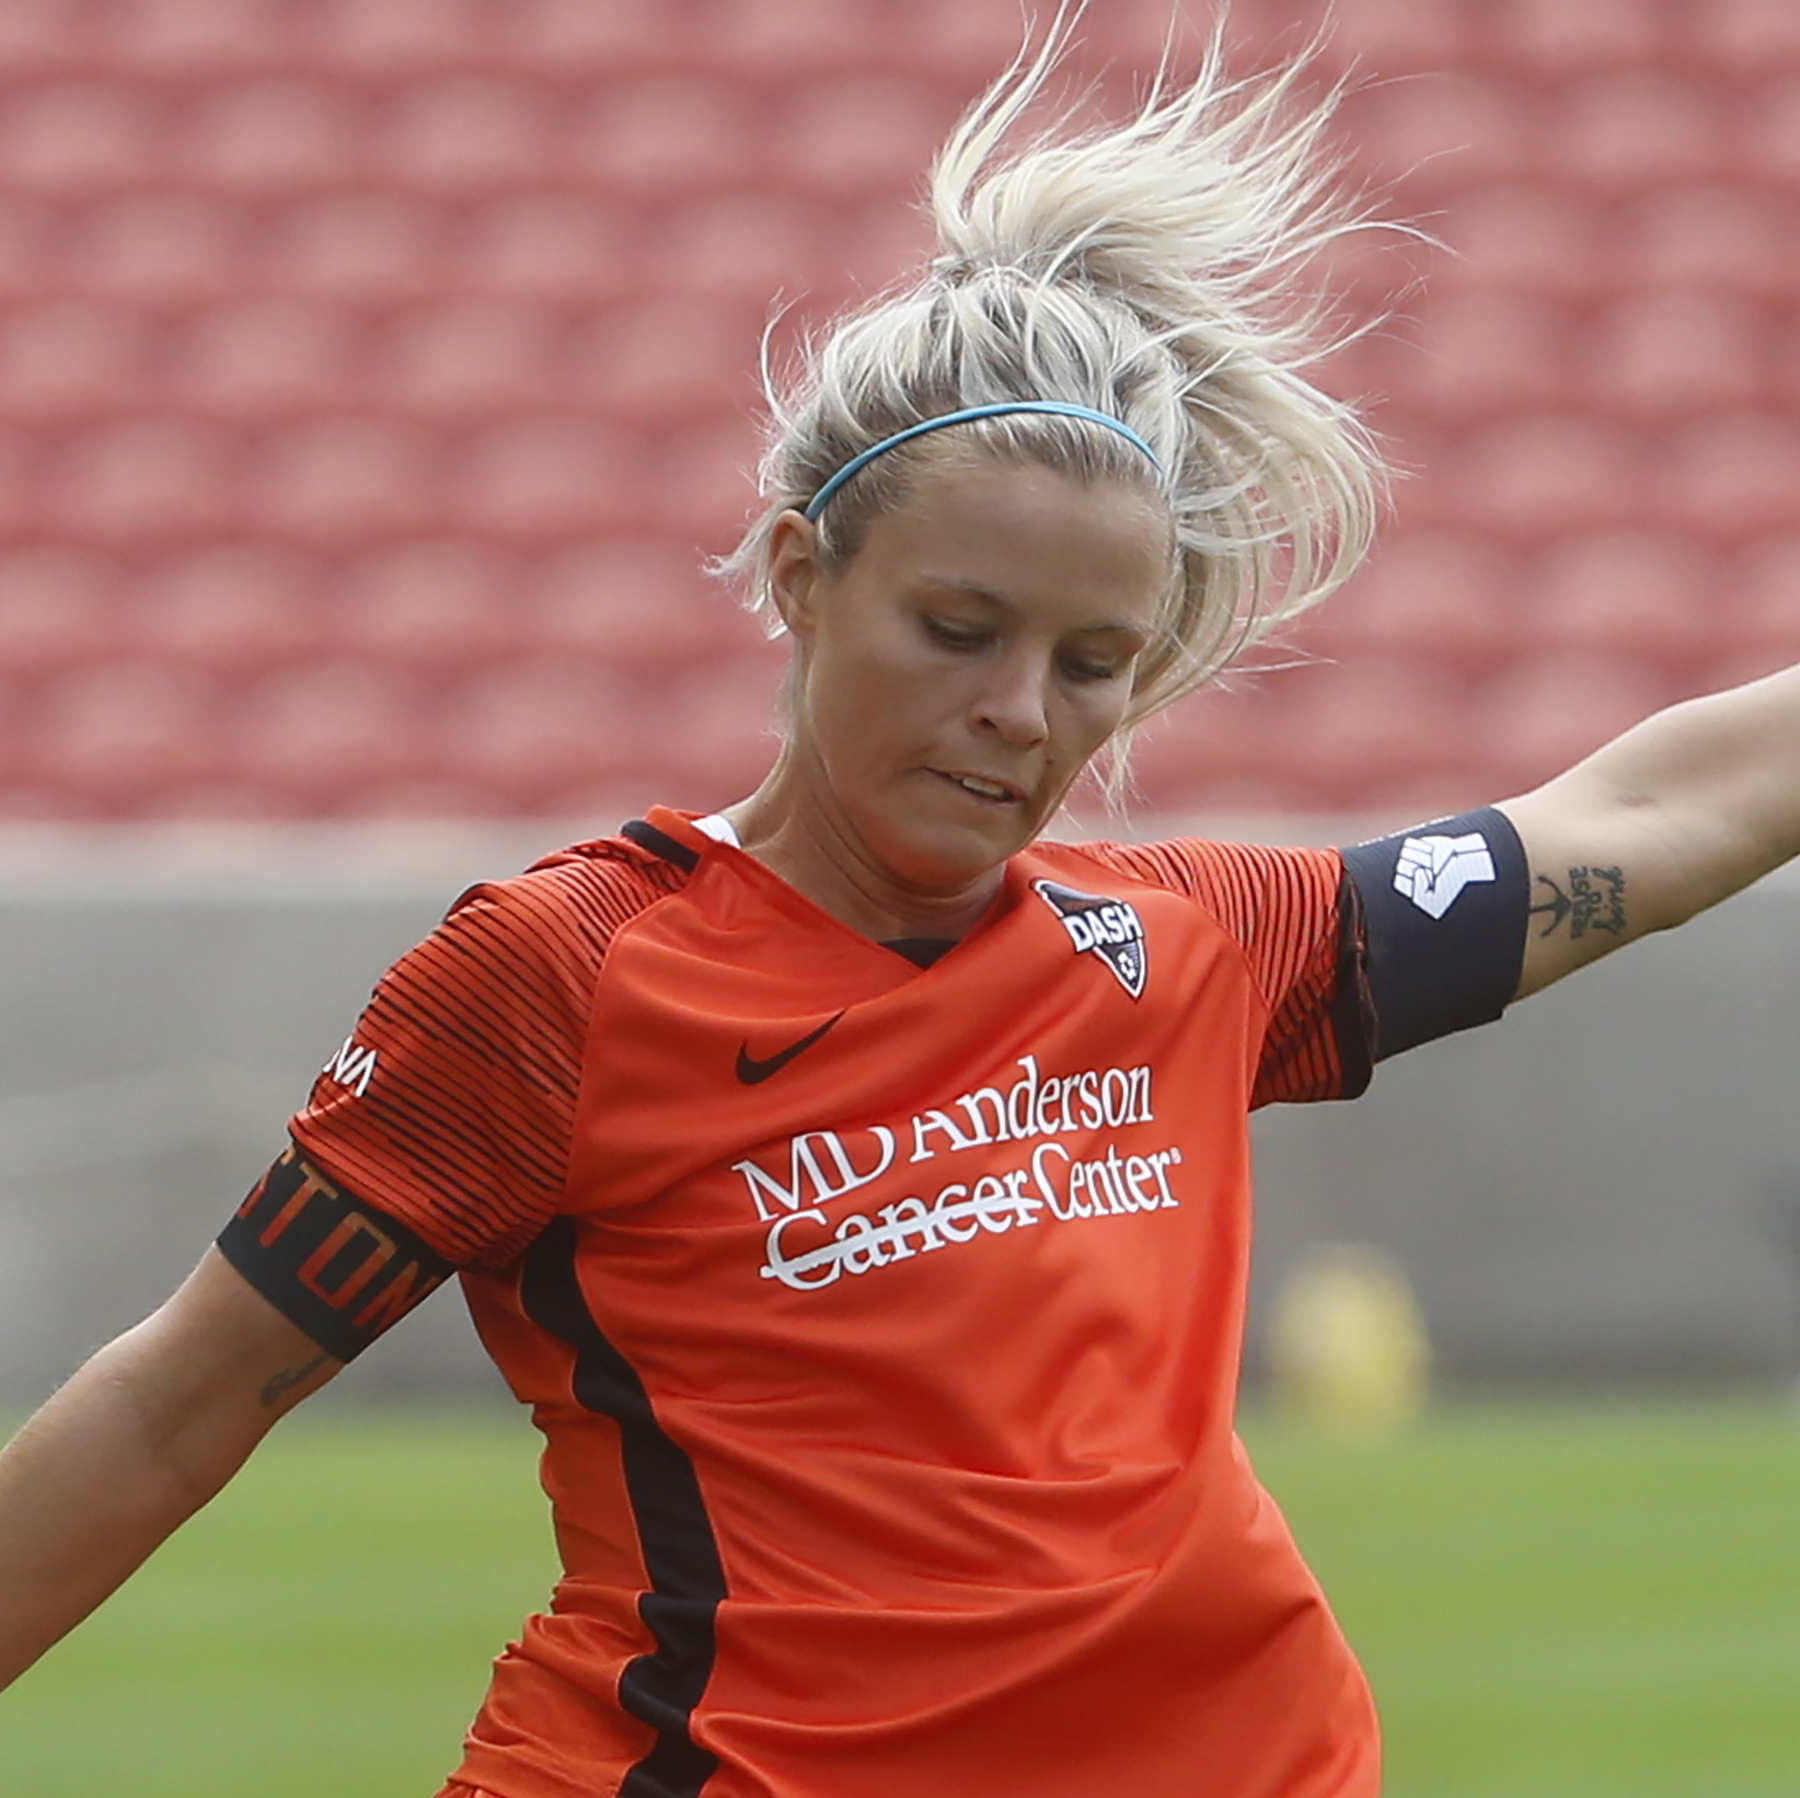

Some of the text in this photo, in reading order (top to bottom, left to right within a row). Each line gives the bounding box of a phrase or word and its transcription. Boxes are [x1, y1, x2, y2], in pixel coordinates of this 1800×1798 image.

[1061, 903, 1143, 952] DASH
[323, 1035, 377, 1097] VA
[731, 1056, 1155, 1222] MD Anderson
[762, 1169, 1042, 1290] Cancer
